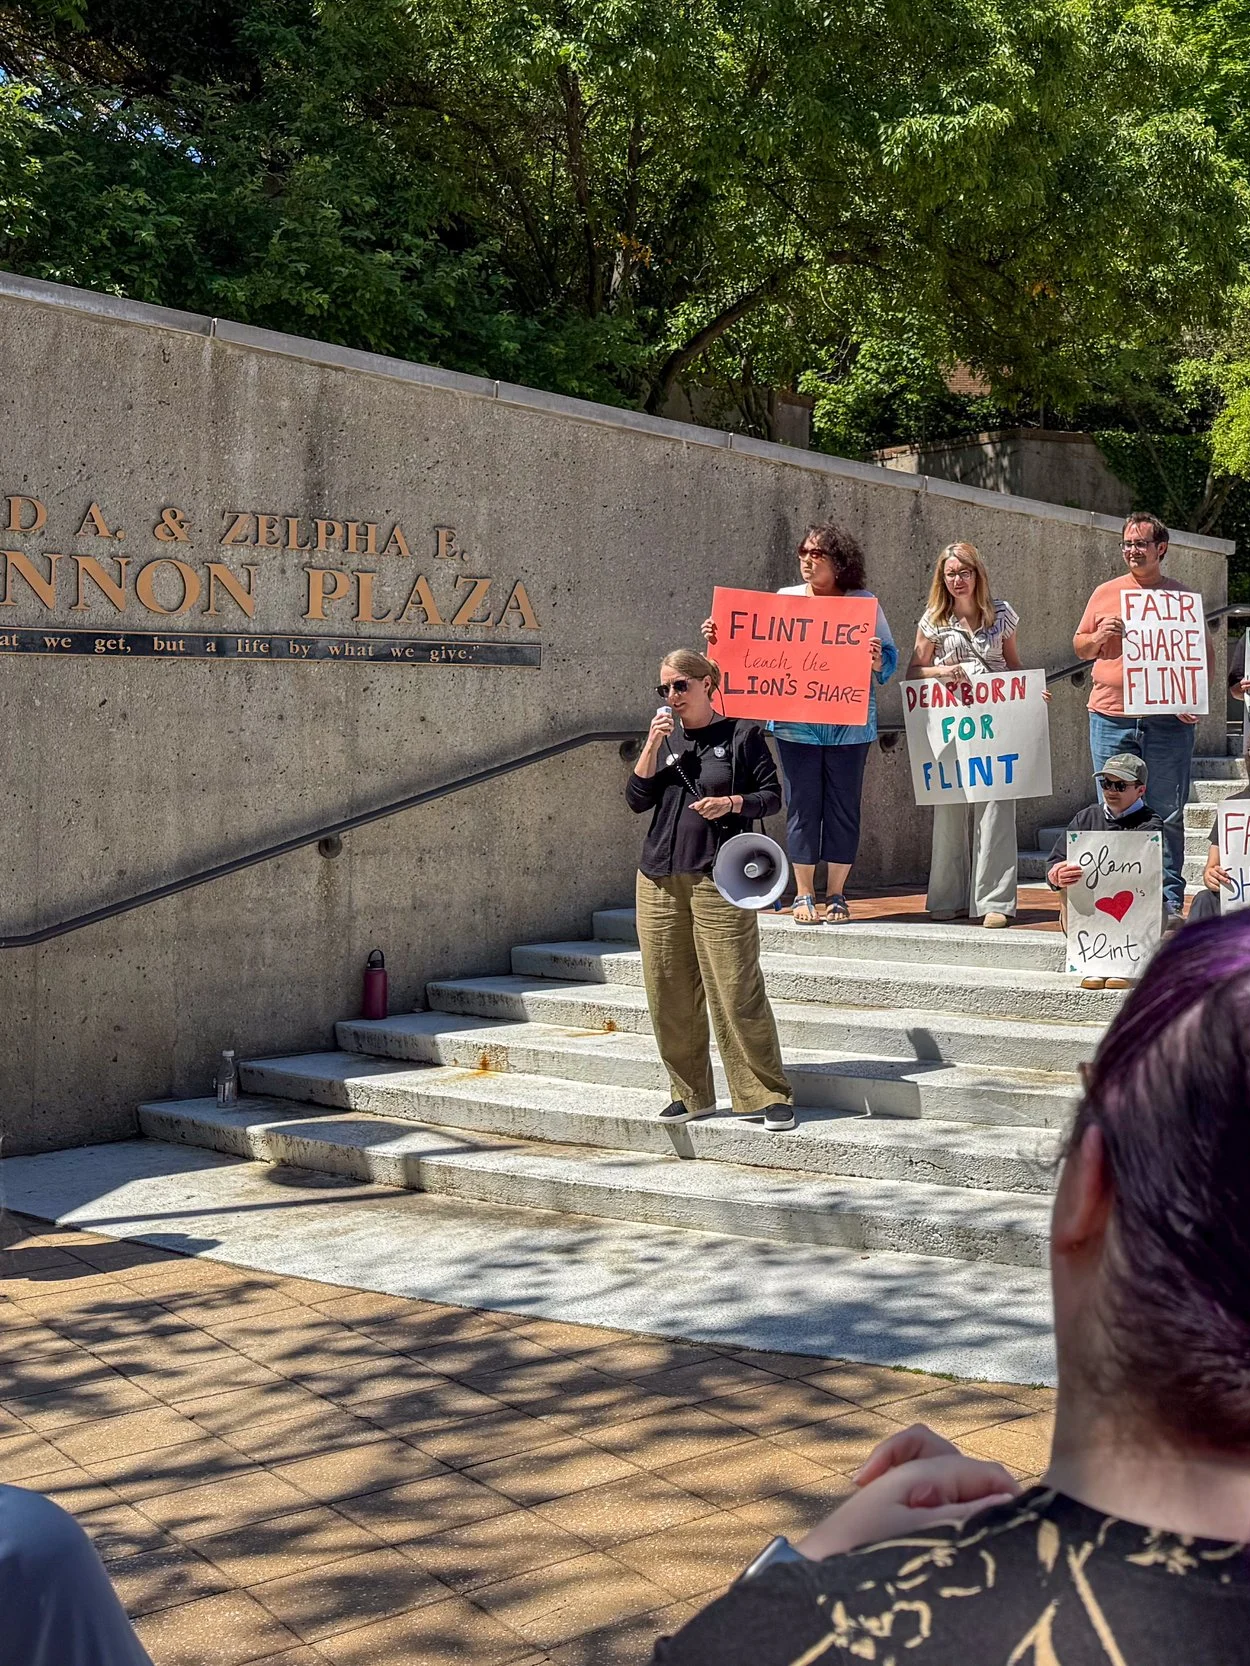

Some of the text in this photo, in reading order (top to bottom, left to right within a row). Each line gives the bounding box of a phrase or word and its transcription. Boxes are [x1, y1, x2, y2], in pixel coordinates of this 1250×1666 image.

[5, 496, 469, 561] D A. & ZELPHA E.
[302, 567, 541, 629] PLAZA
[1125, 593, 1197, 623] FAIR
[729, 610, 814, 642] FLINT
[44, 636, 72, 649] we
[94, 637, 131, 653] get,
[153, 636, 185, 651] but
[206, 641, 217, 652] a
[237, 638, 270, 653] life
[289, 640, 311, 657] by
[328, 643, 374, 657] what
[390, 645, 415, 658] we
[743, 648, 830, 672] teach the
[1125, 628, 1202, 662] SHARE
[803, 680, 866, 703] SHARE
[905, 675, 1027, 713] DEARBORN
[1126, 666, 1204, 705] FLINT
[941, 714, 995, 744] FOR
[922, 753, 1020, 791] FLINT
[1079, 845, 1142, 889] glam
